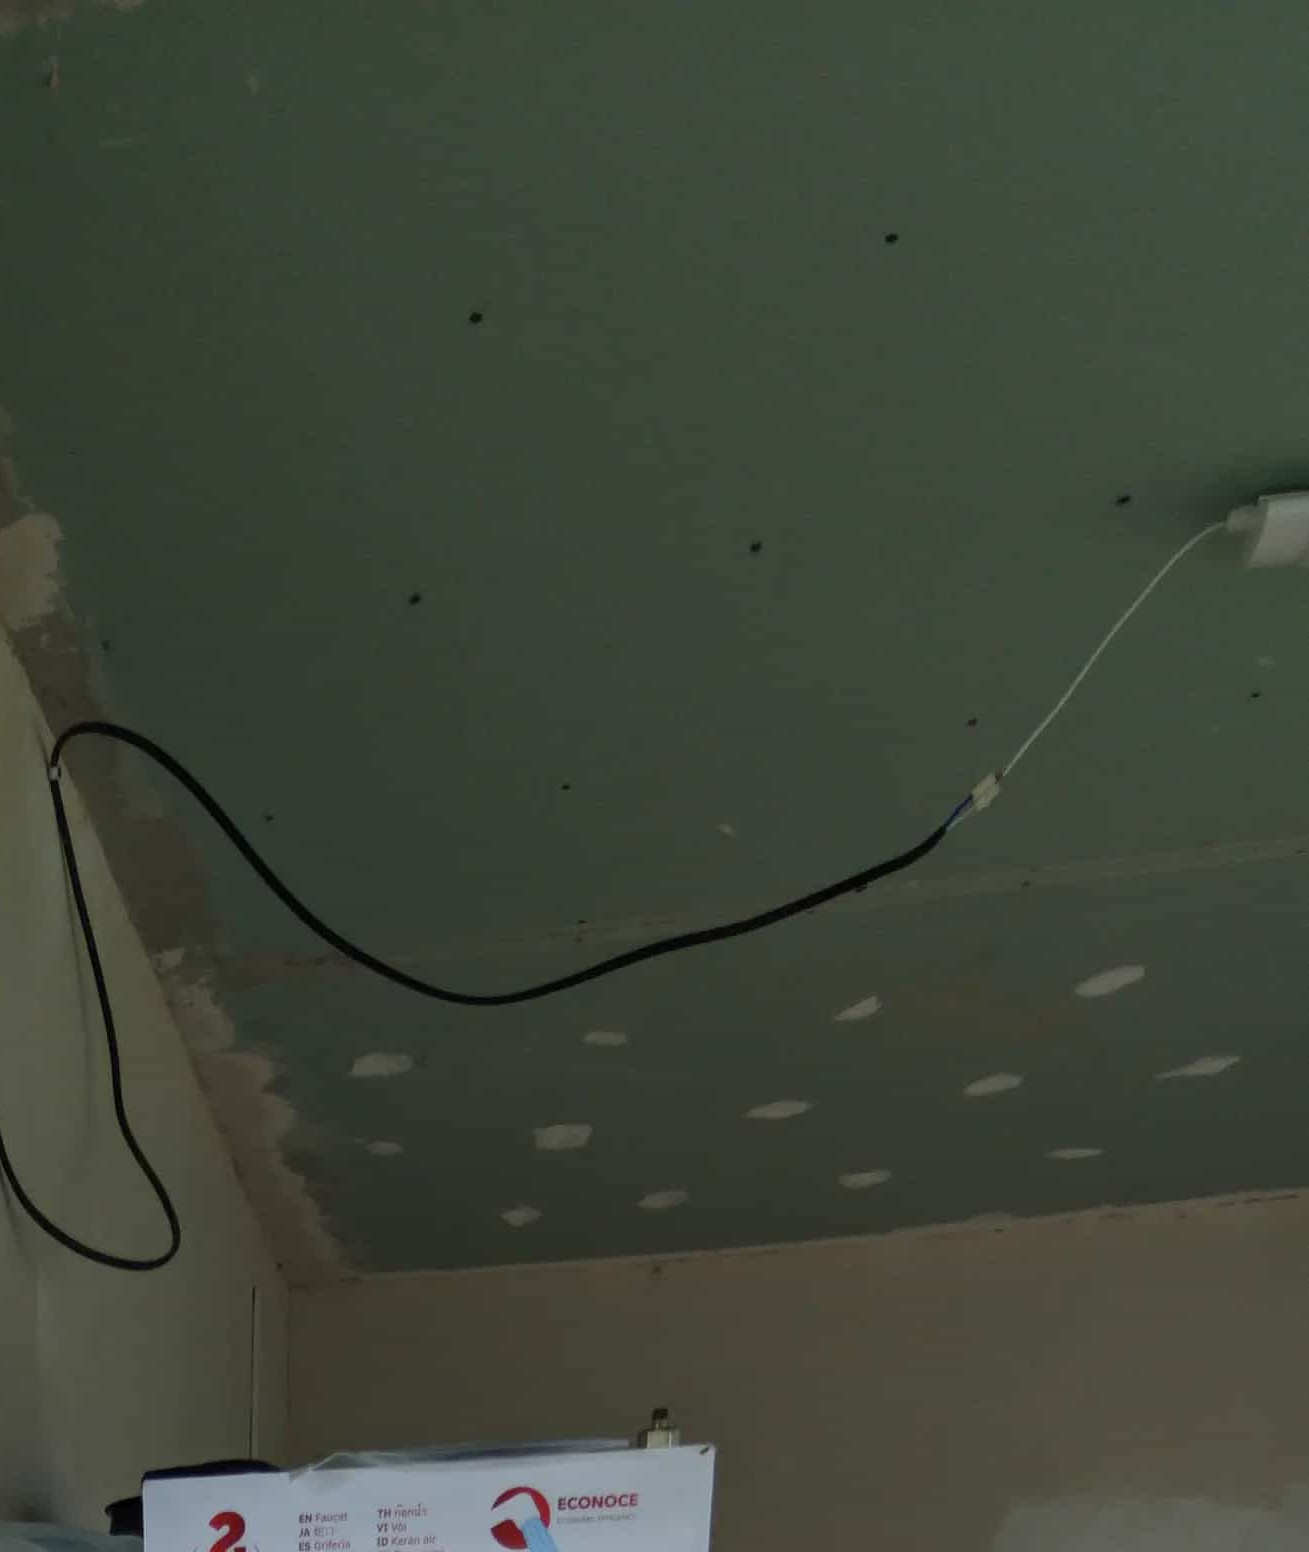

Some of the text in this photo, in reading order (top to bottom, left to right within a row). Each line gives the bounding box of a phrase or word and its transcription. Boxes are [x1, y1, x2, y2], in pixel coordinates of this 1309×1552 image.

[557, 1493, 638, 1511] ECONOCE
[299, 1512, 348, 1524] EN Faucet
[378, 1508, 391, 1519] TH
[299, 1527, 311, 1538] JA
[377, 1523, 388, 1533] VI
[299, 1542, 311, 1552] ES
[377, 1536, 389, 1547] ID
[391, 1536, 420, 1546] Keran
